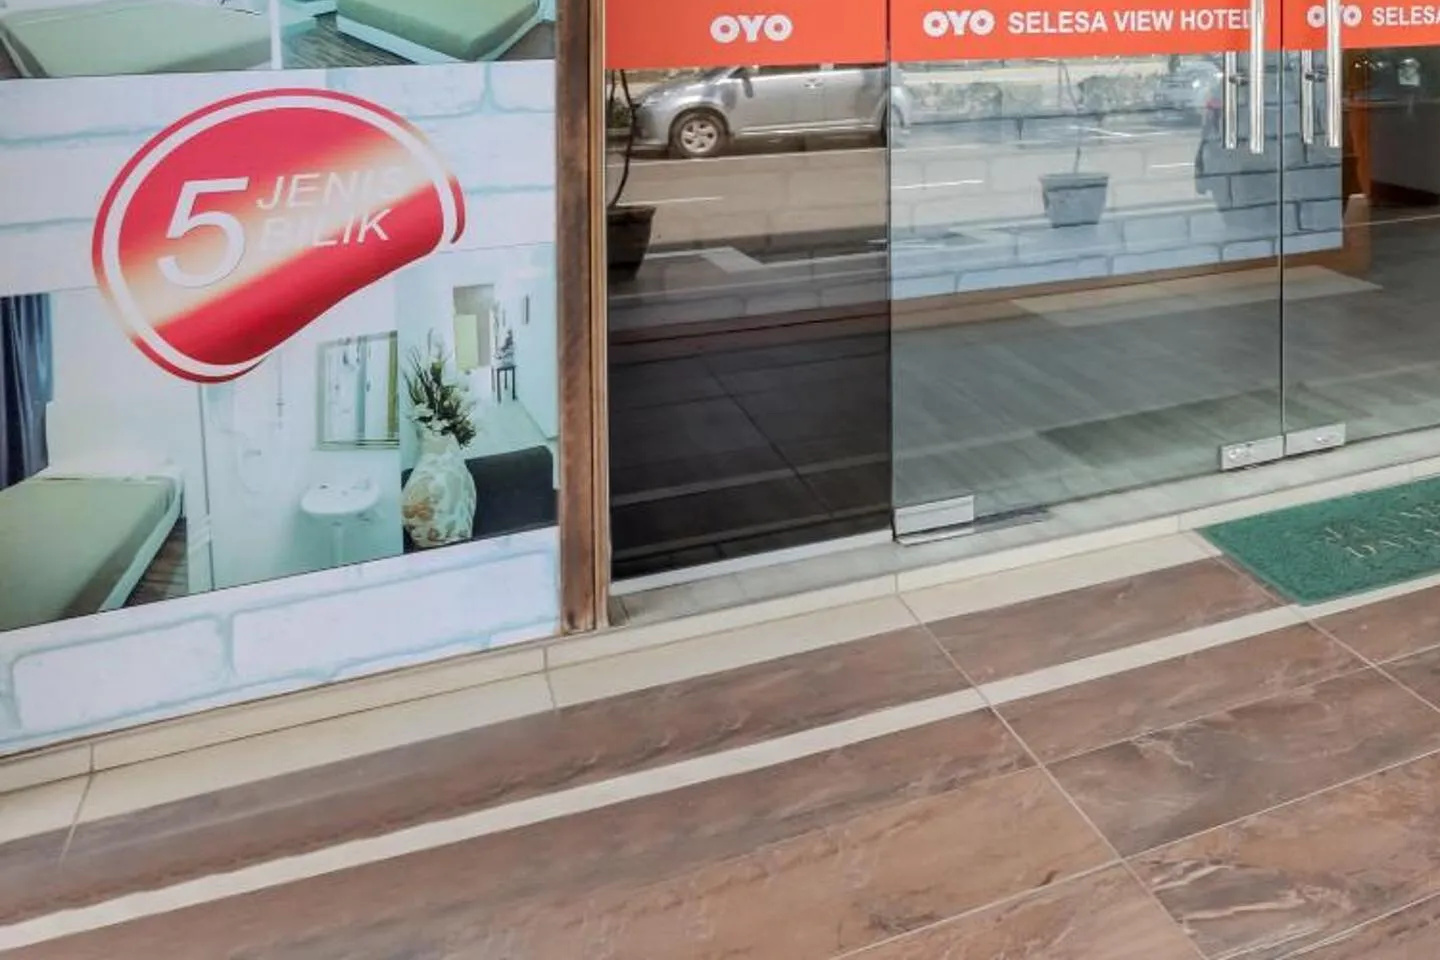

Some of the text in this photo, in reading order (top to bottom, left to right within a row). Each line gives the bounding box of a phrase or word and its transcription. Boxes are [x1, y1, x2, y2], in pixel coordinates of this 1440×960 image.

[710, 14, 793, 43] OYO
[922, 8, 1254, 37] OYO SELESA VIEW HOTEL
[256, 167, 402, 210] JENIS
[156, 176, 248, 288] 5
